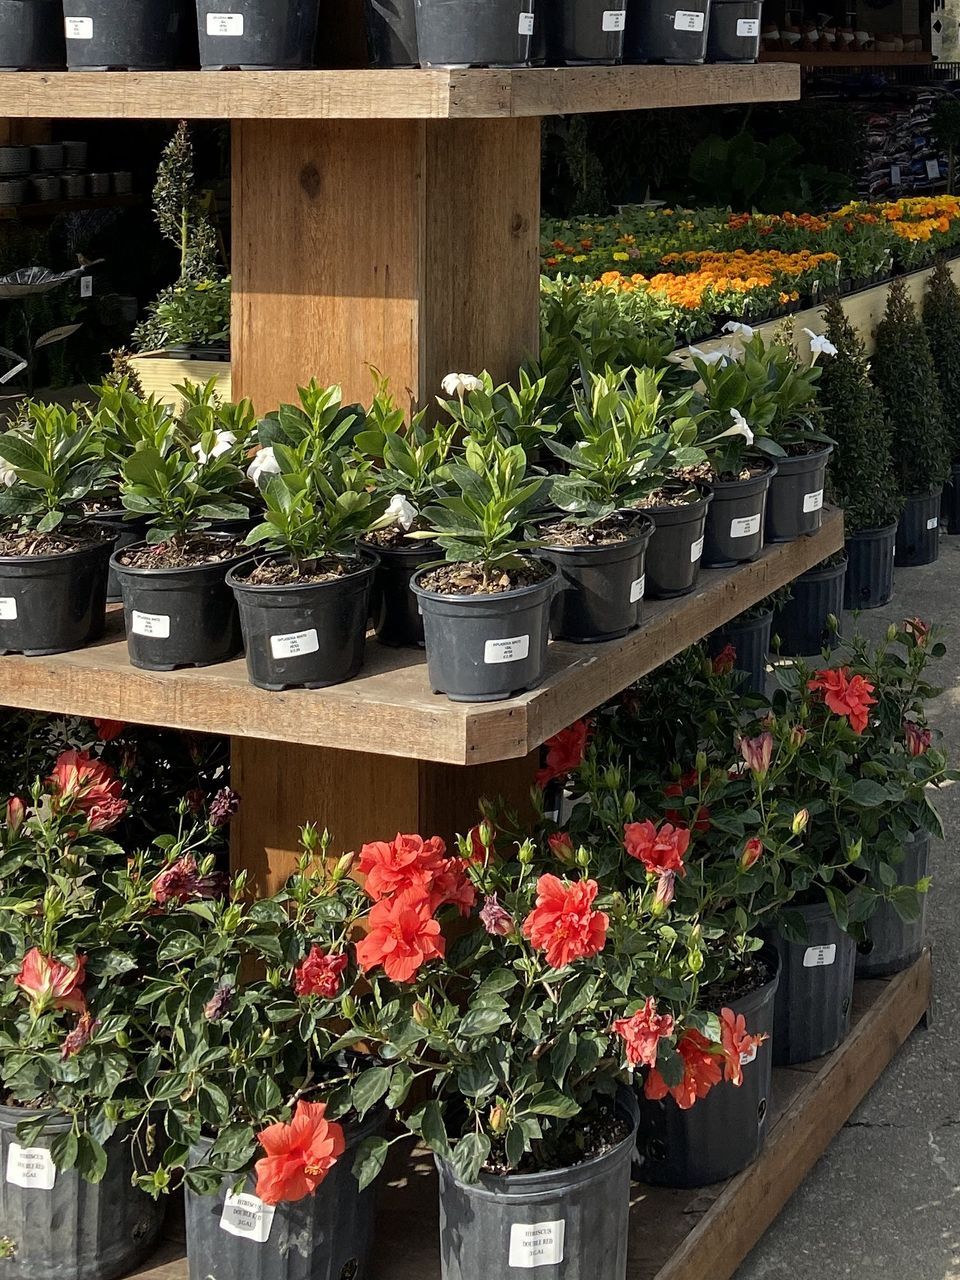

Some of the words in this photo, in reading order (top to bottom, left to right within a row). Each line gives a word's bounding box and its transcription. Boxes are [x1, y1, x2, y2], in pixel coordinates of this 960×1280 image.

[237, 1199, 262, 1211] HIBISCUS
[232, 1208, 251, 1218] DOUBLE
[525, 1228, 552, 1237] HIBISCUS
[522, 1239, 541, 1247] DOUBLE
